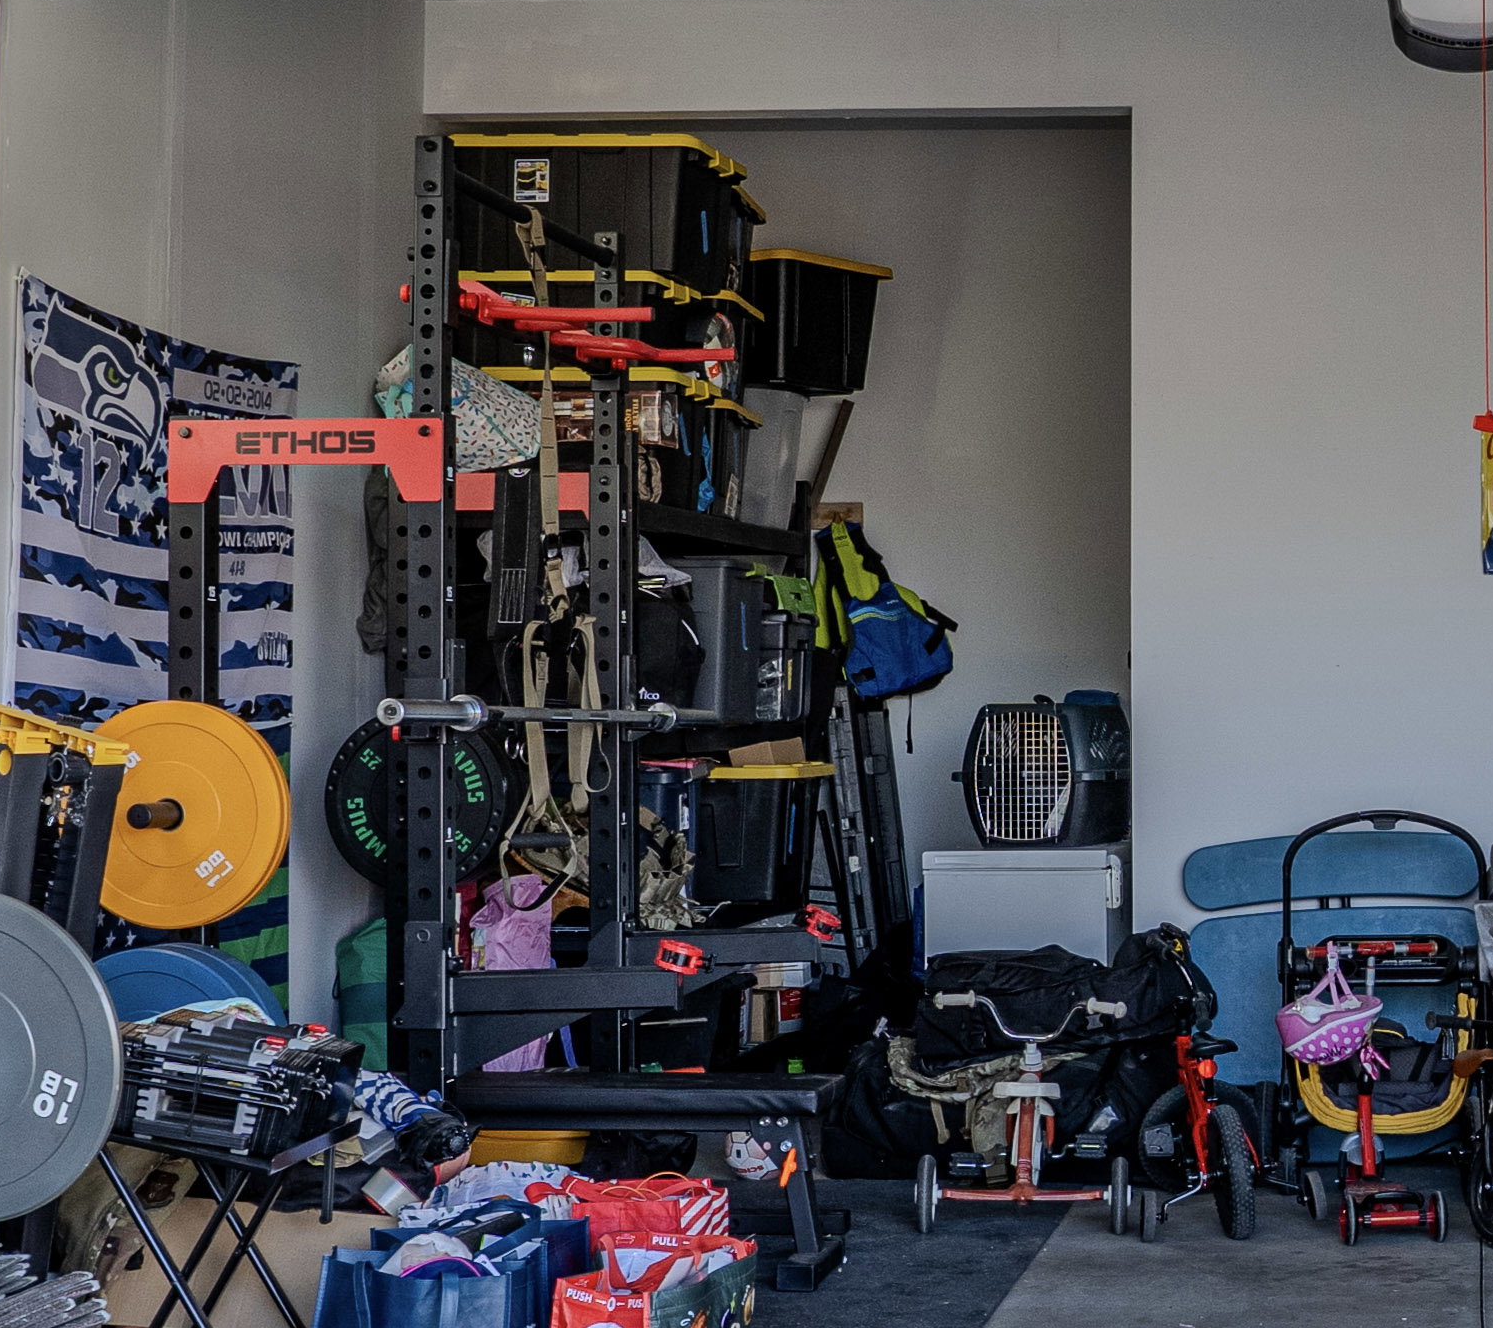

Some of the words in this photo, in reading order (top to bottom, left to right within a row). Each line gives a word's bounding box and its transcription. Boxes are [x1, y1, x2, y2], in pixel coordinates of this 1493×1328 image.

[235, 430, 376, 455] ETHOS
[78, 433, 121, 538] 12
[651, 1236, 679, 1248] PULL
[565, 1288, 593, 1304] PUSH
